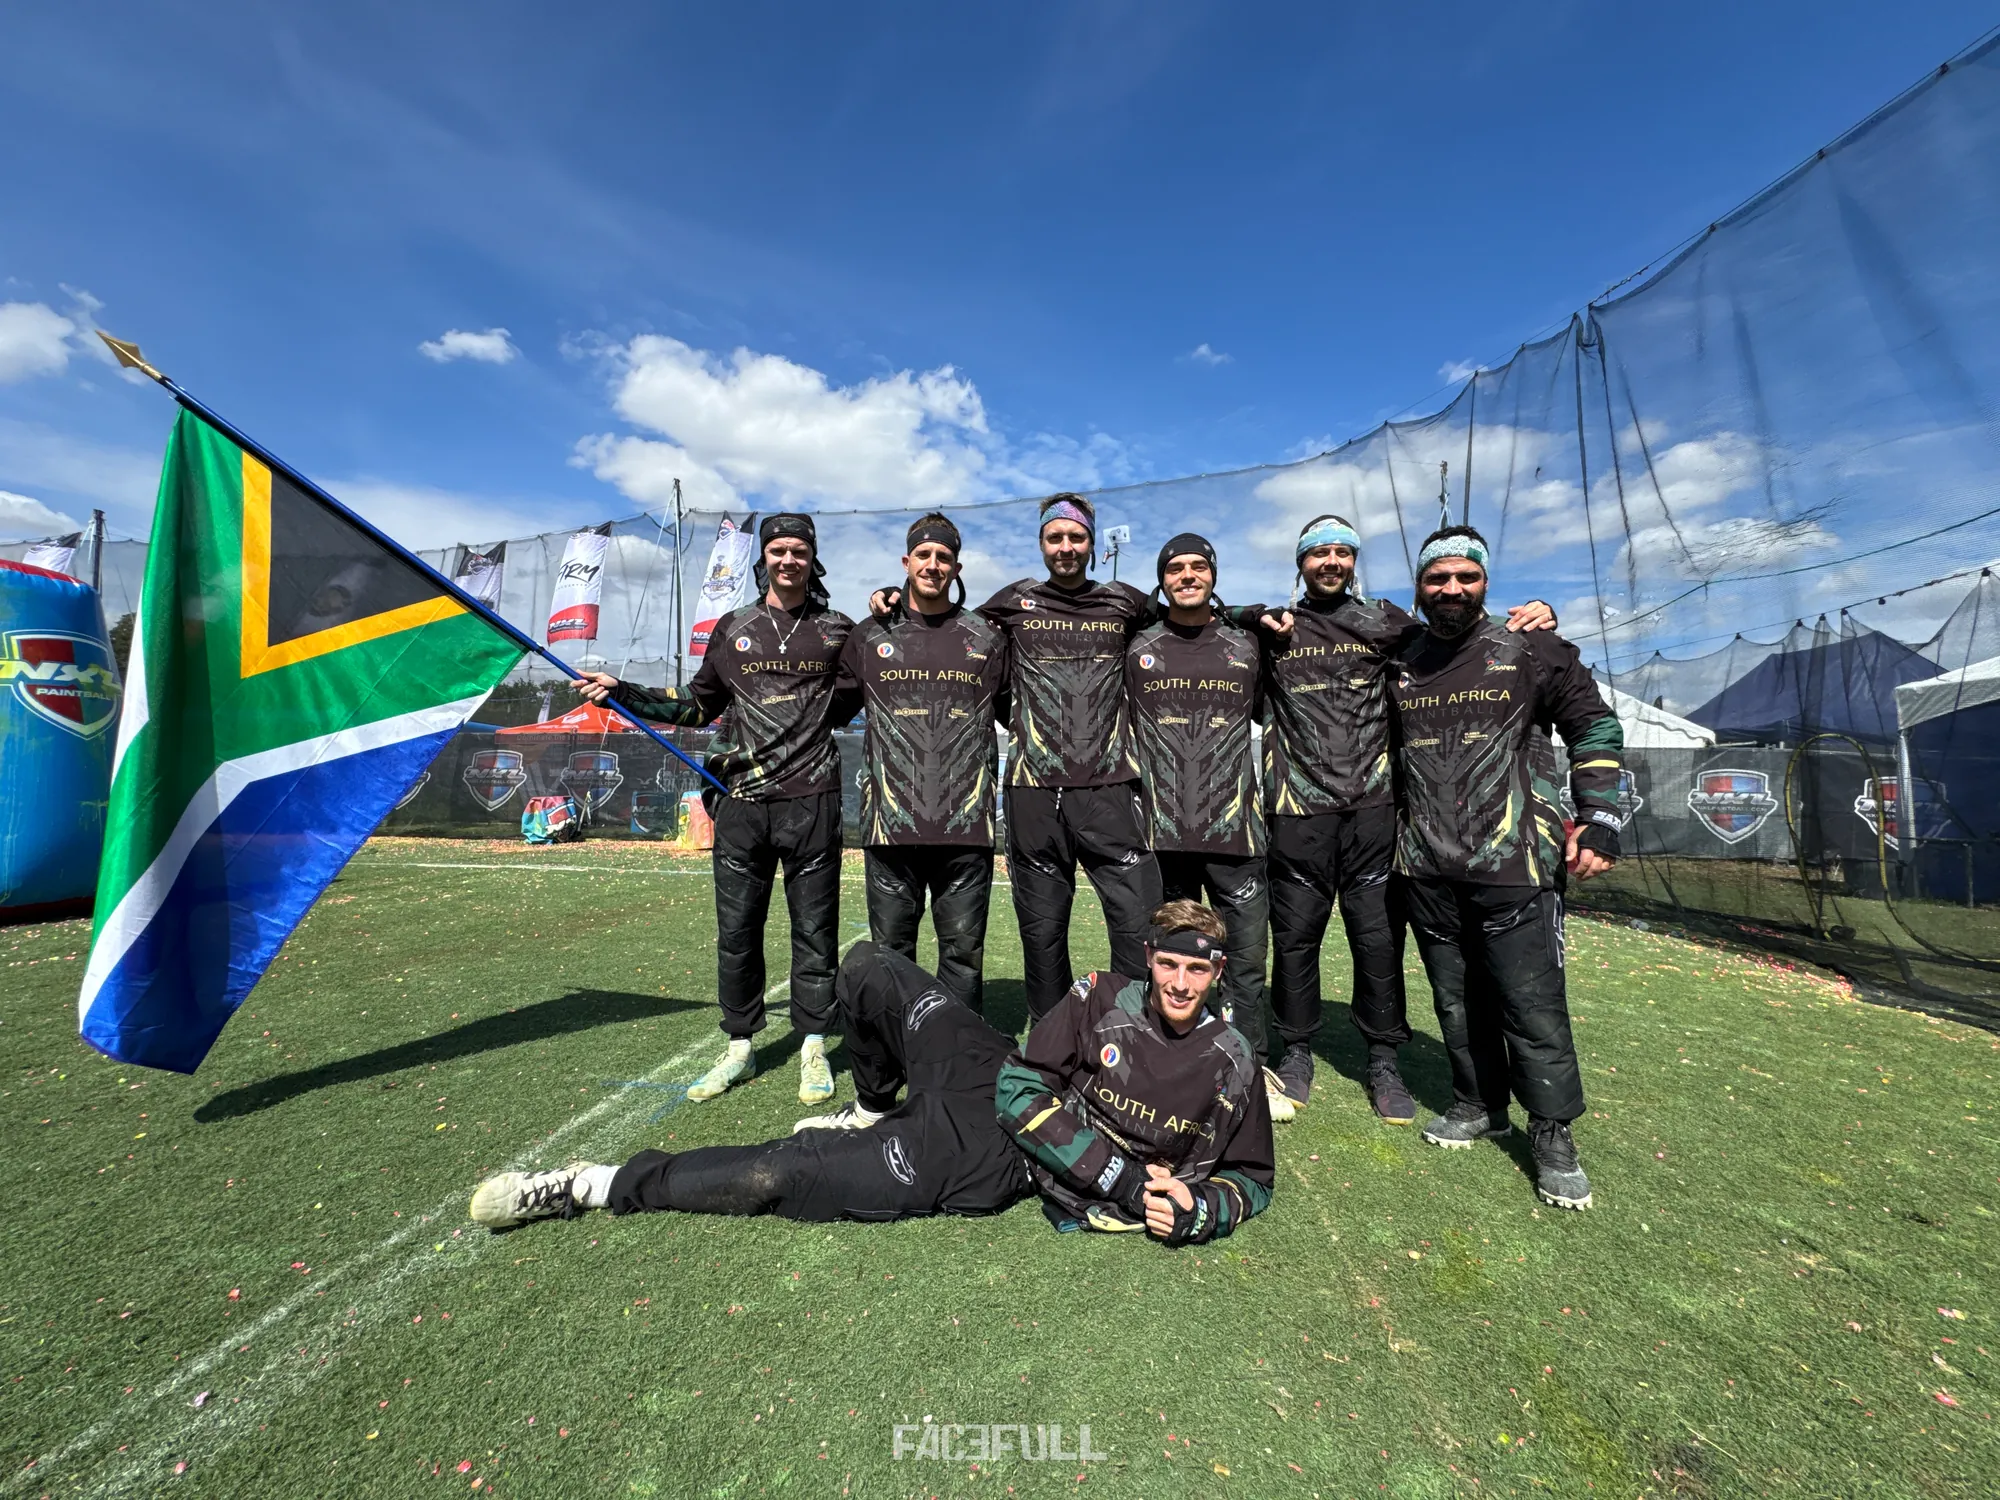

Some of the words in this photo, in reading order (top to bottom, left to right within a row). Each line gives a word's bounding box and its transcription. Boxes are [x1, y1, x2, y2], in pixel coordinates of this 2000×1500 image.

[1022, 619, 1073, 631] SOUTH
[1332, 643, 1377, 655] AFRIC
[741, 660, 790, 675] SOUTH
[1283, 654, 1359, 671] PAINTBA
[879, 669, 929, 682] SOUTH
[936, 669, 983, 688] AFRICA
[1143, 678, 1191, 693] SOUTH
[36, 687, 112, 700] PAINTBALL
[889, 682, 969, 696] PAINTBAL
[1397, 695, 1440, 712] OUTH
[1447, 689, 1512, 706] AFRICA
[466, 768, 524, 779] NXL
[1692, 791, 1775, 806] NXL
